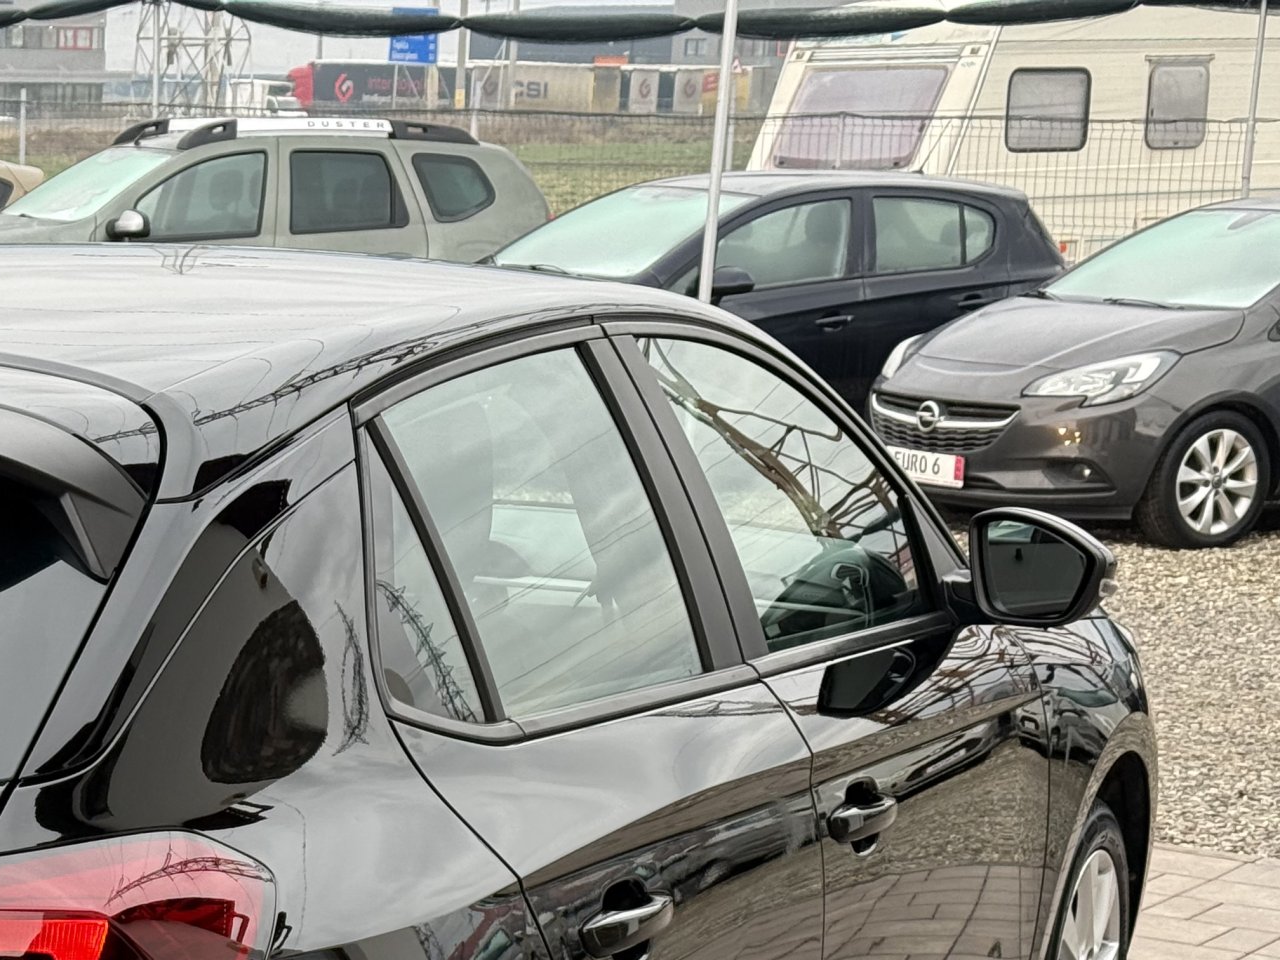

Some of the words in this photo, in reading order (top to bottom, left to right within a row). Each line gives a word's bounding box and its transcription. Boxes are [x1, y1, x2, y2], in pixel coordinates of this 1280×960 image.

[307, 120, 385, 129] DUSTER
[894, 451, 928, 474] EURO
[931, 456, 941, 475] 6
